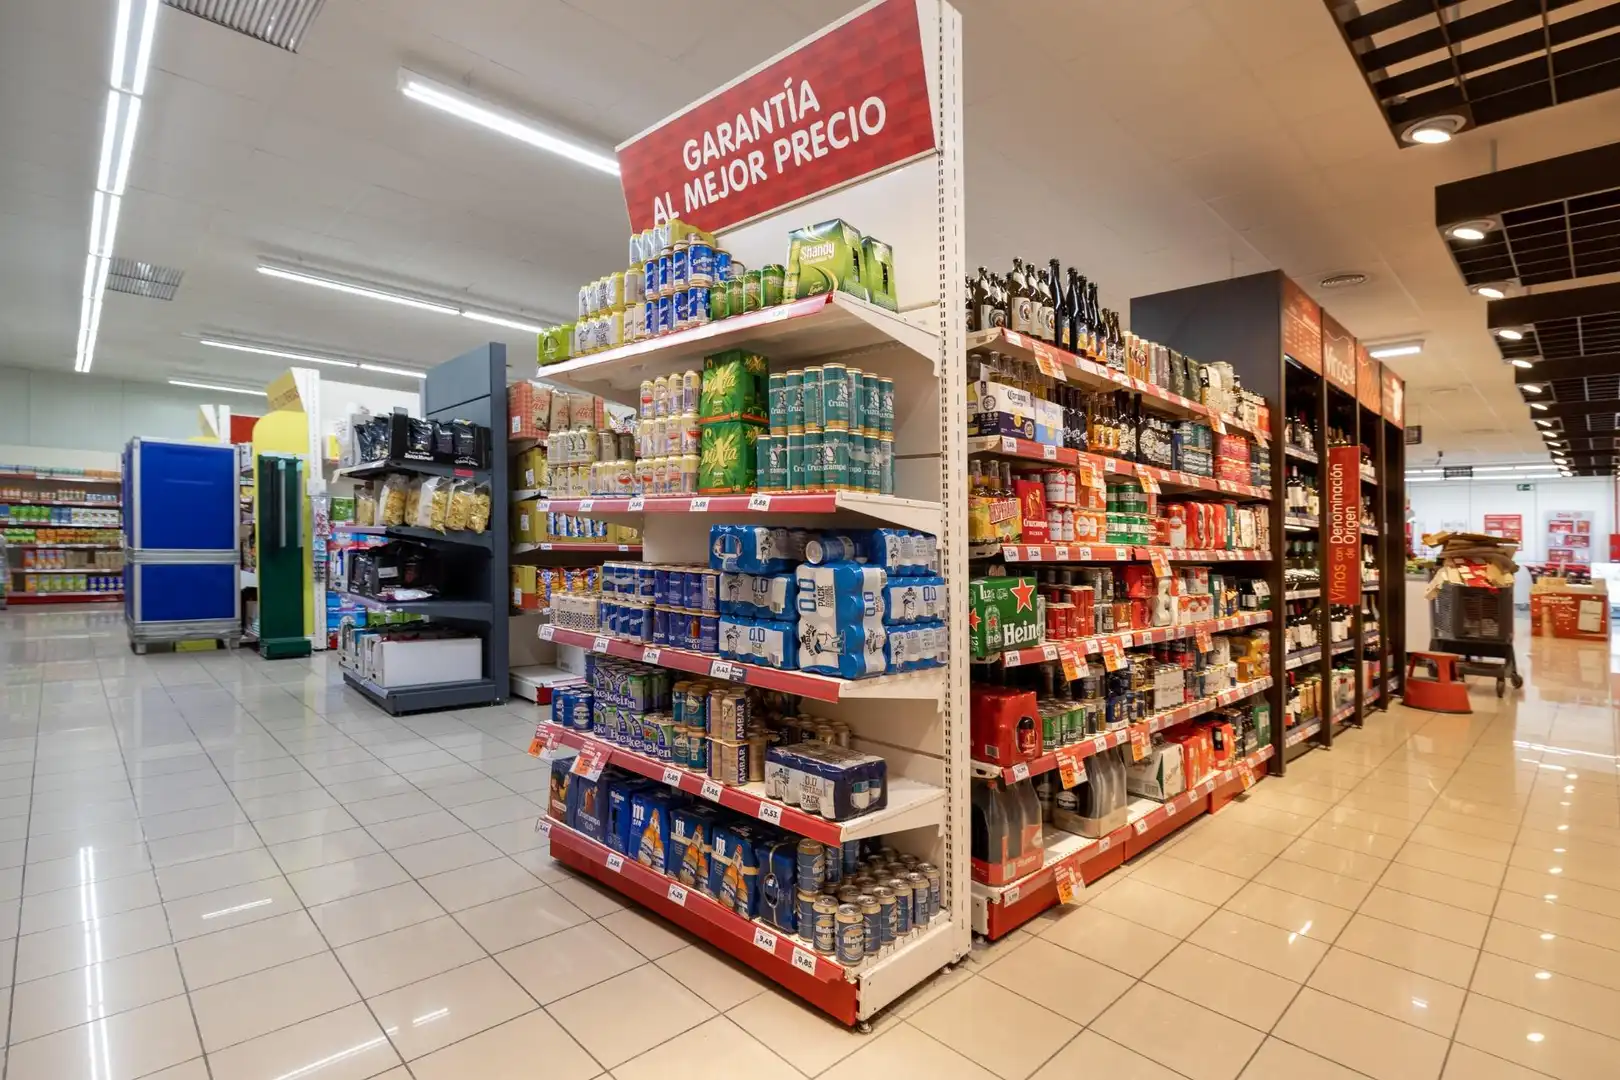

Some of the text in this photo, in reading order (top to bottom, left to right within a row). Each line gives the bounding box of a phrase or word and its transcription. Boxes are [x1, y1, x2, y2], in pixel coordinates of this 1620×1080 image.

[683, 77, 820, 171] GARANTÍA
[653, 96, 886, 225] AL MEJOR PRECIO
[800, 241, 834, 260] Shandy
[1330, 463, 1346, 601] Vinos con Denominación
[1343, 506, 1360, 558] de Origen
[736, 703, 745, 739] AMBAR
[738, 748, 746, 782] AMBAR
[759, 935, 773, 947] 9,49
[797, 955, 812, 968] 0,85
